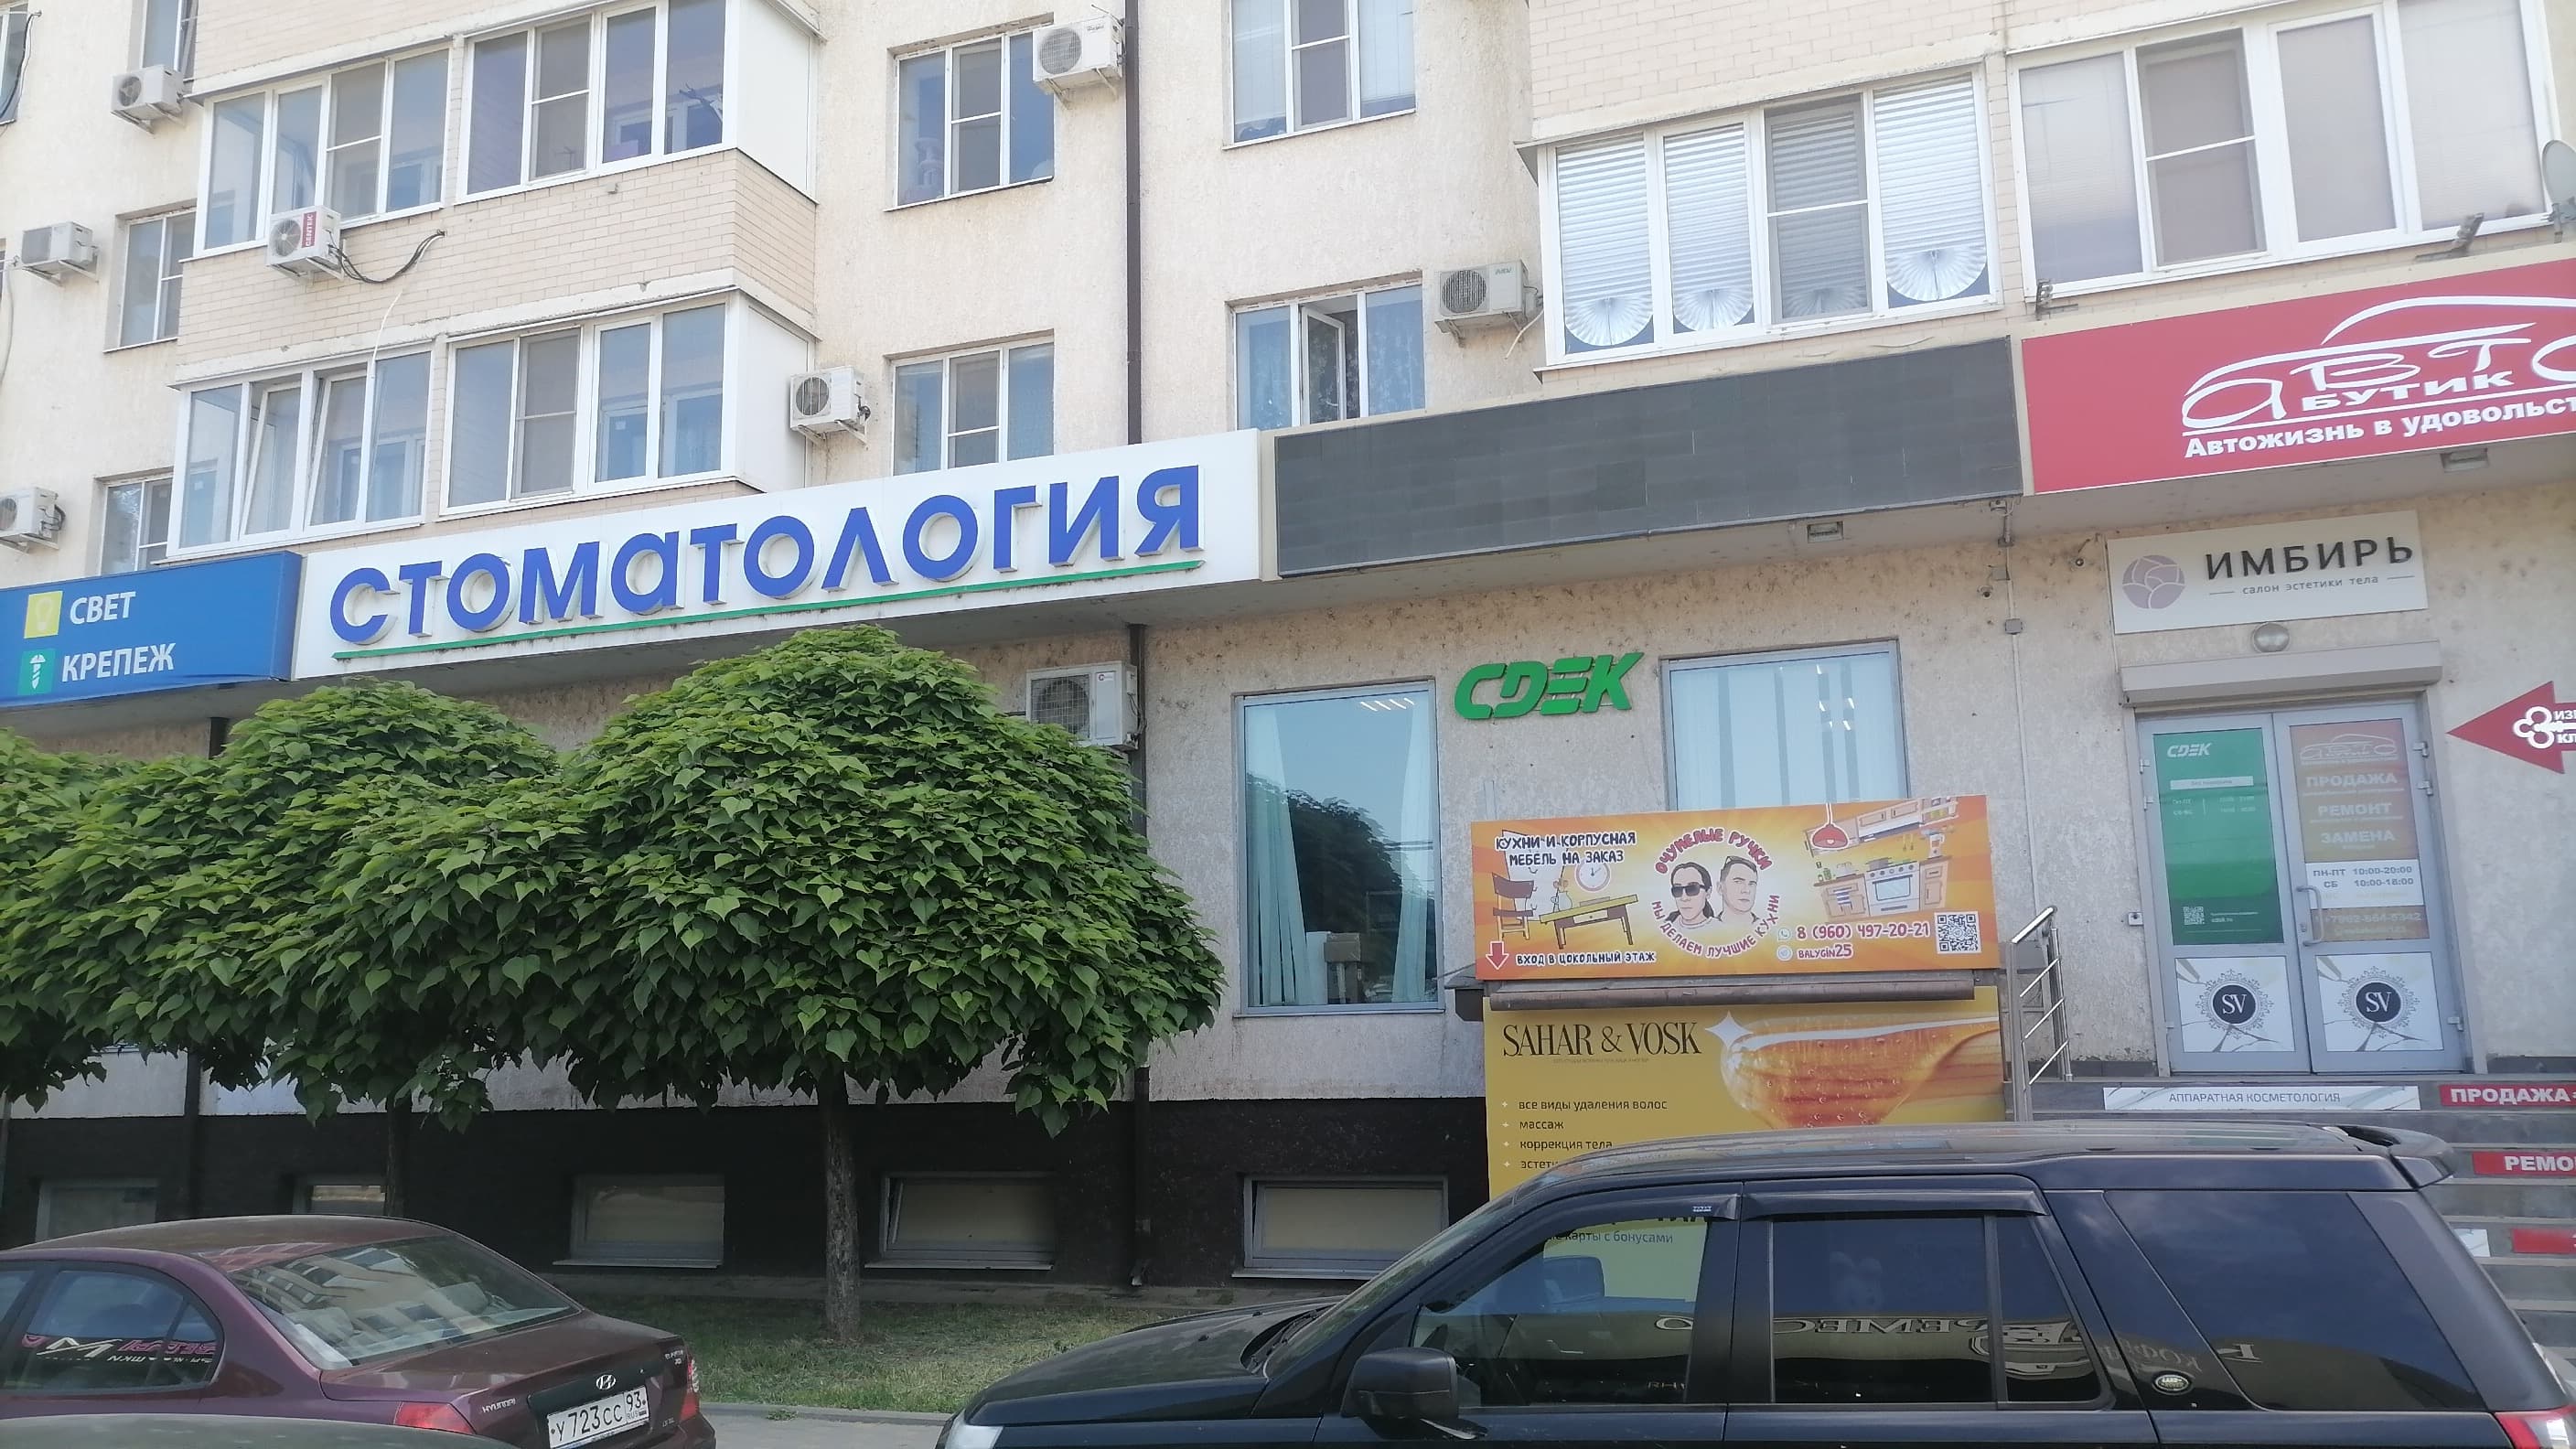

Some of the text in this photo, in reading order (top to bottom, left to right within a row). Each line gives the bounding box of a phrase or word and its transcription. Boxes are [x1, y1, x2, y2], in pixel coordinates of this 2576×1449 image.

[2302, 370, 2515, 413] БУТИК
[2184, 422, 2365, 458] Автожизнь
[2375, 421, 2393, 435] в
[2205, 536, 2413, 580] ИМБИРЬ
[2242, 574, 2379, 596] салон эстетики тела
[70, 591, 136, 625] СВЕТ
[61, 644, 176, 683] КРЕПЕЖ
[1454, 652, 1645, 720] CDEK
[2306, 773, 2398, 788] ПРОДАЖА
[2318, 803, 2392, 817] РЕМОНТ
[1497, 832, 1636, 850] КУХНИ И КОРПУСНАЯ
[2321, 830, 2396, 843] ЗАМЕНА
[1509, 850, 1625, 866] МЕБЕЛЬ НА ЗАКАЗ
[1728, 831, 1773, 871] РУЧКИ
[2324, 880, 2339, 888] СБ
[1651, 895, 1780, 957] МЫ ДЕЛАЕМ ЛУЧШИЕ КУХНИ
[1797, 922, 1930, 939] 8 (960) 497-20-21
[1517, 951, 1656, 965] ВХОД В ЦОКОЛЬНЫЙ ЭТАЖ
[1503, 1021, 1702, 1057] SAHAR & VOSK
[2169, 1092, 2341, 1102] АППАРАТНАЯ КОСМЕТОЛОГИЯ
[2451, 1088, 2571, 1105] ПРОДАЖА
[1519, 1100, 1668, 1111] все виды удаления волос
[1519, 1121, 1563, 1130] массаж
[1520, 1141, 1612, 1151] коррекция тела
[2504, 1155, 2576, 1171] РЕМО
[1615, 1230, 1673, 1244] бонусами
[627, 1390, 641, 1411] 93
[628, 1411, 639, 1420] RUS
